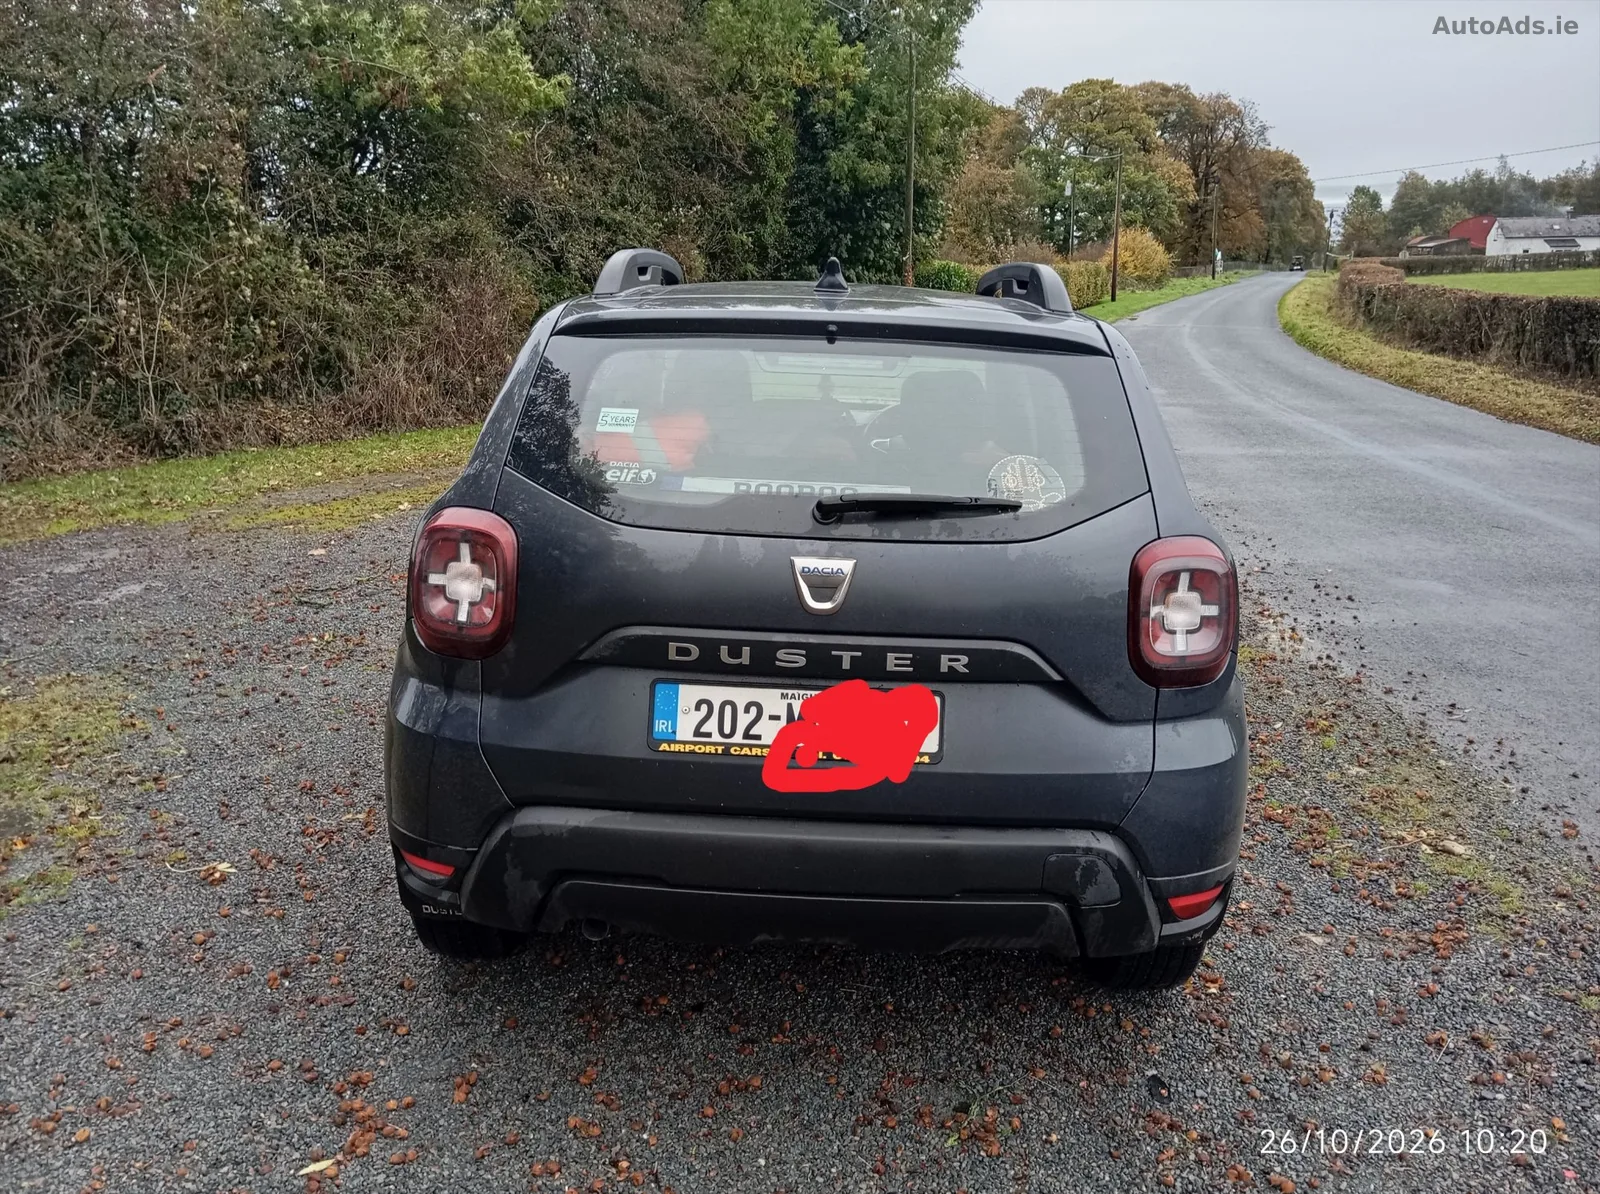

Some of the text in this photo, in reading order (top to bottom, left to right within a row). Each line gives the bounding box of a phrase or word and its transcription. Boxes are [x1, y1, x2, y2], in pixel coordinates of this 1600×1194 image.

[600, 414, 608, 426] 5
[610, 415, 636, 424] YEARS
[801, 566, 845, 576] DACIA
[668, 641, 970, 674] DUSTER
[655, 719, 673, 733] IRL
[658, 742, 771, 757] AIRPORT CARS
